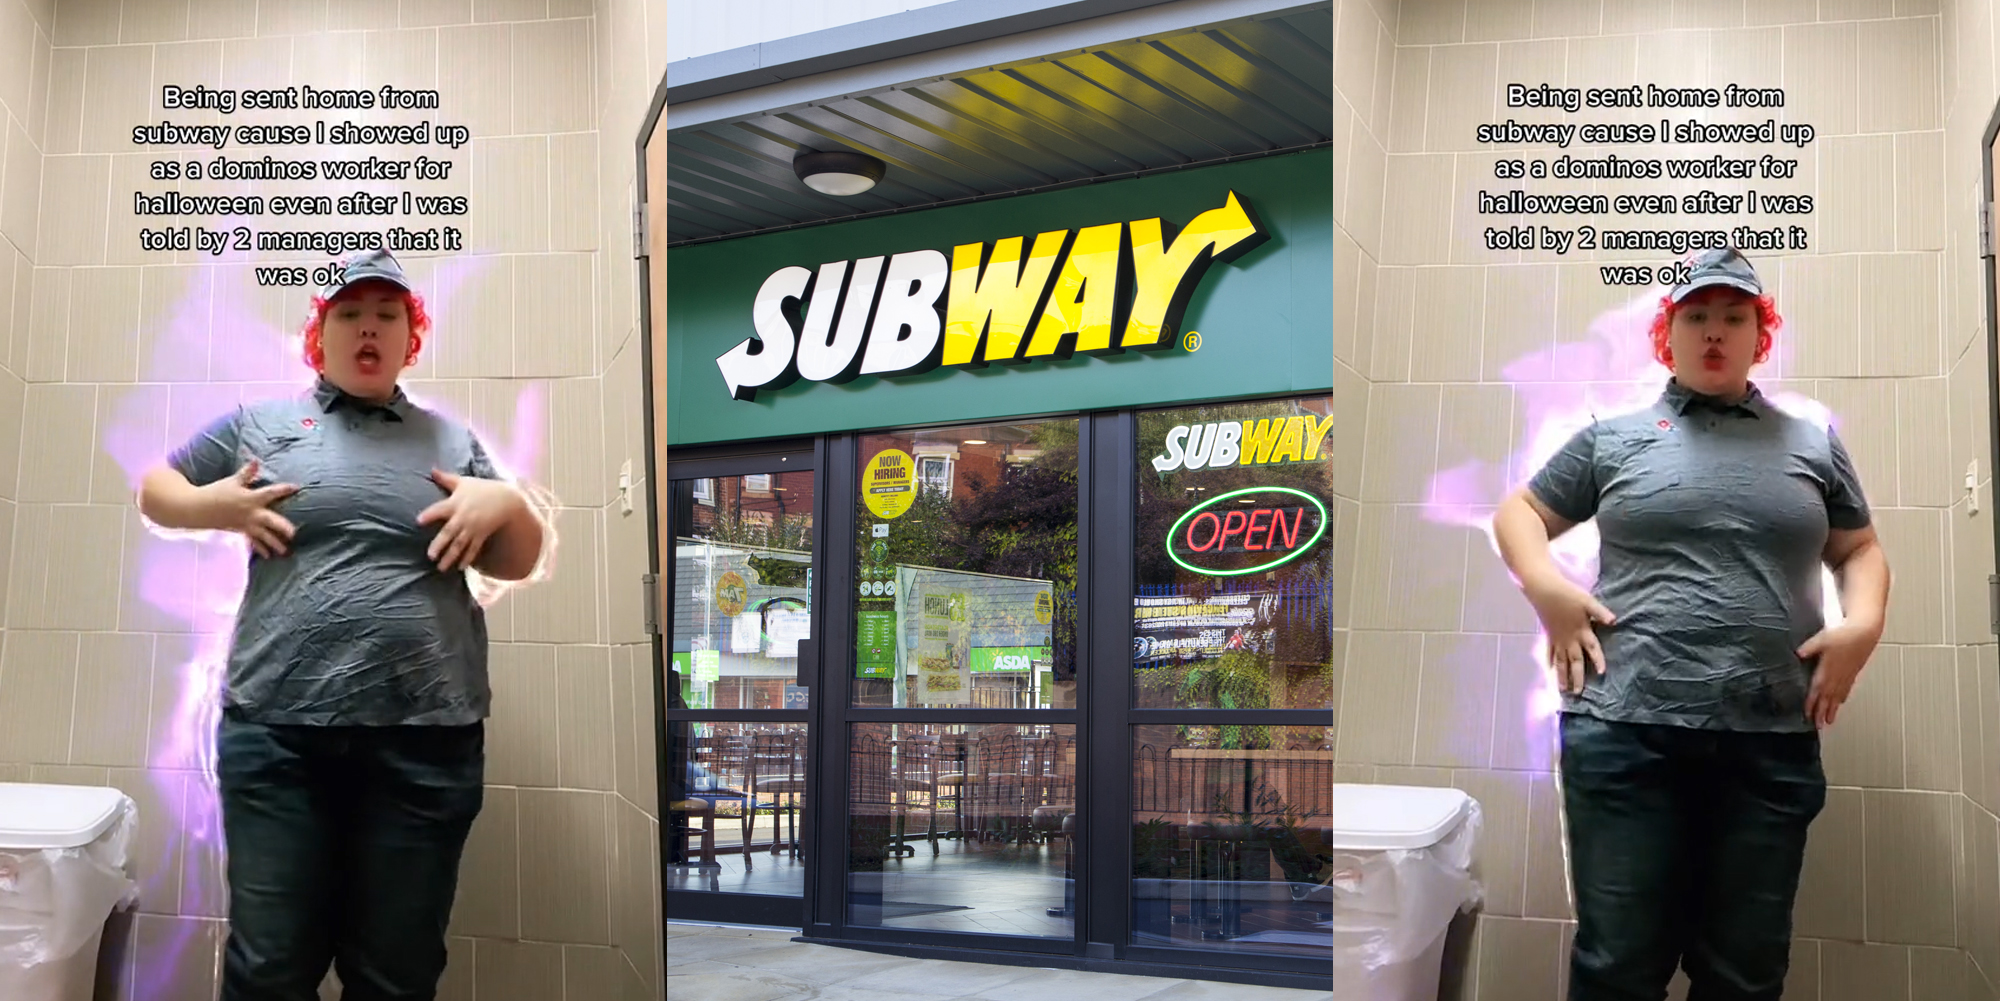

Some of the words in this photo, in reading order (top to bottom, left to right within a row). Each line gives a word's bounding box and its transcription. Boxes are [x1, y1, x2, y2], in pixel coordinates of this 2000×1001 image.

[715, 189, 1257, 400] SUBWAY
[1152, 414, 1333, 472] SUBWAY
[874, 467, 906, 480] HIRING
[879, 455, 901, 468] NOW
[1187, 508, 1303, 552] OPEN
[993, 655, 1031, 670] ASDA
